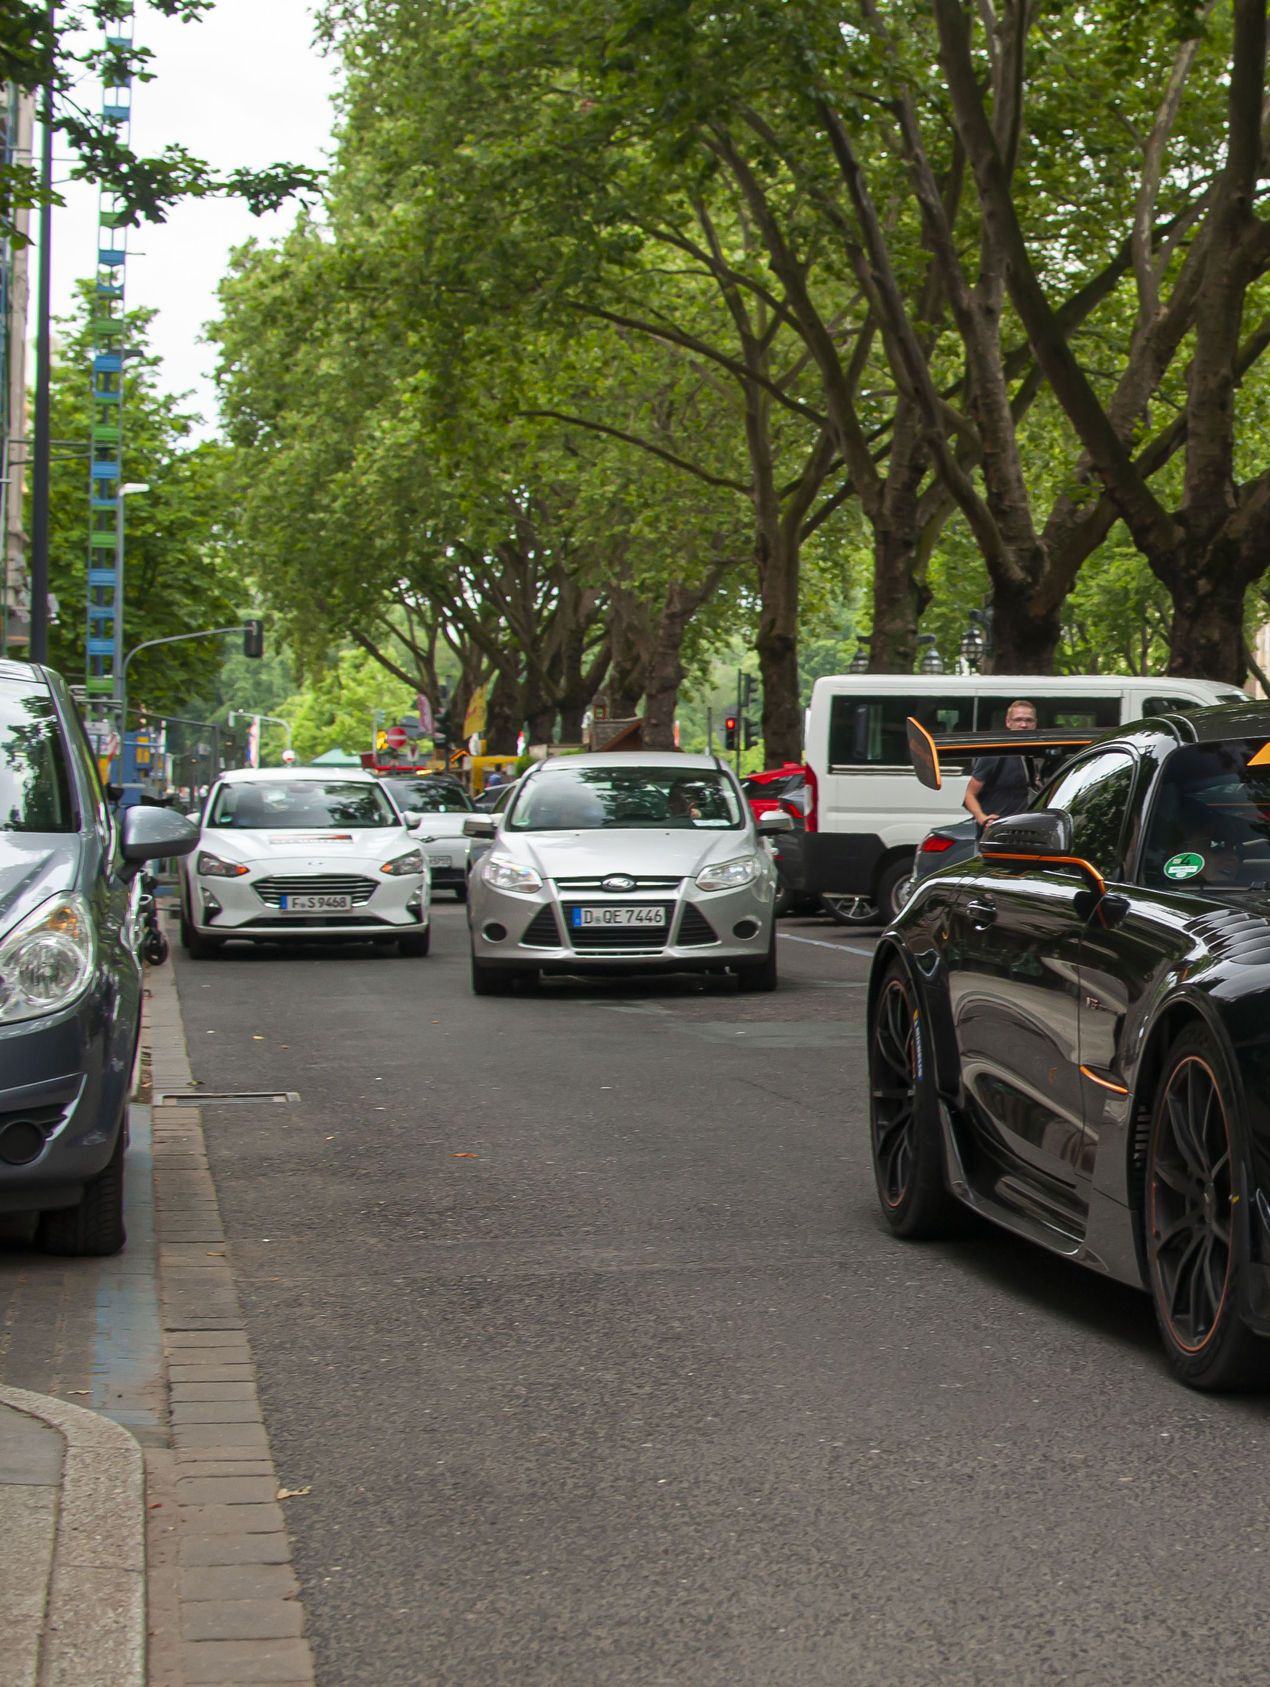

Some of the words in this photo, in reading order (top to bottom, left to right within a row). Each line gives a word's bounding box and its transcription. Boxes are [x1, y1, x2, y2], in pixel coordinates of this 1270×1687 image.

[1180, 855, 1191, 865] 4
[292, 897, 300, 909] F
[307, 897, 316, 909] S
[318, 896, 347, 908] 9468
[583, 910, 593, 924] D
[625, 909, 662, 923] 7446
